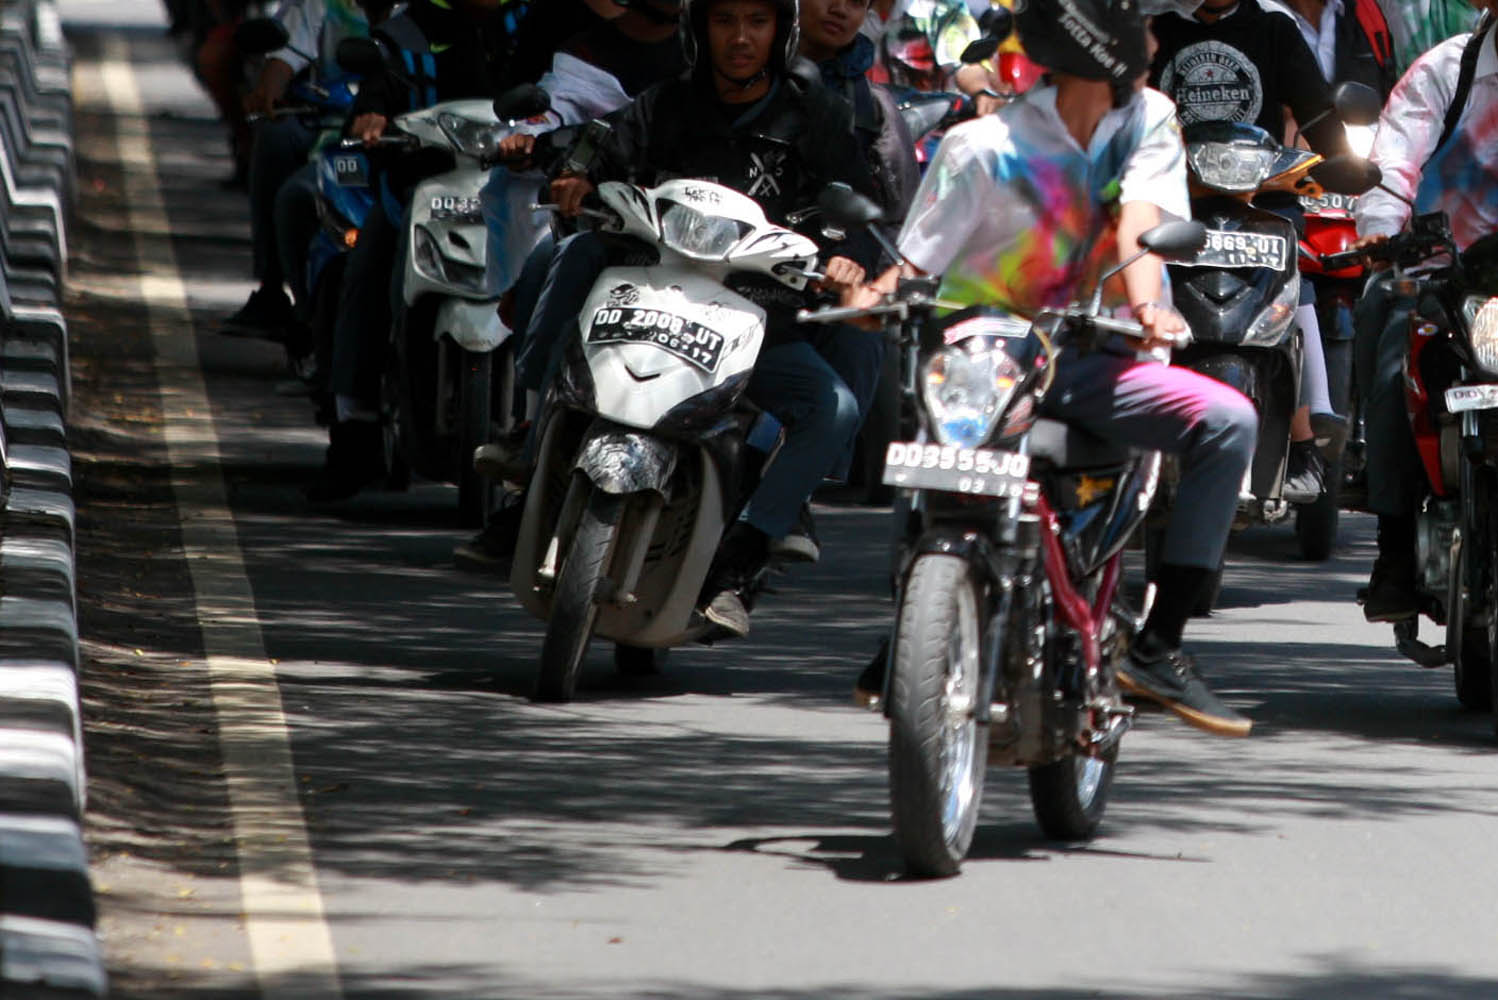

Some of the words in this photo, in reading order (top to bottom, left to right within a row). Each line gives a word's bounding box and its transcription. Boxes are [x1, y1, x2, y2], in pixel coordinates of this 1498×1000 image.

[1176, 85, 1250, 103] Heineken
[595, 309, 622, 325] DD
[695, 327, 722, 351] UT
